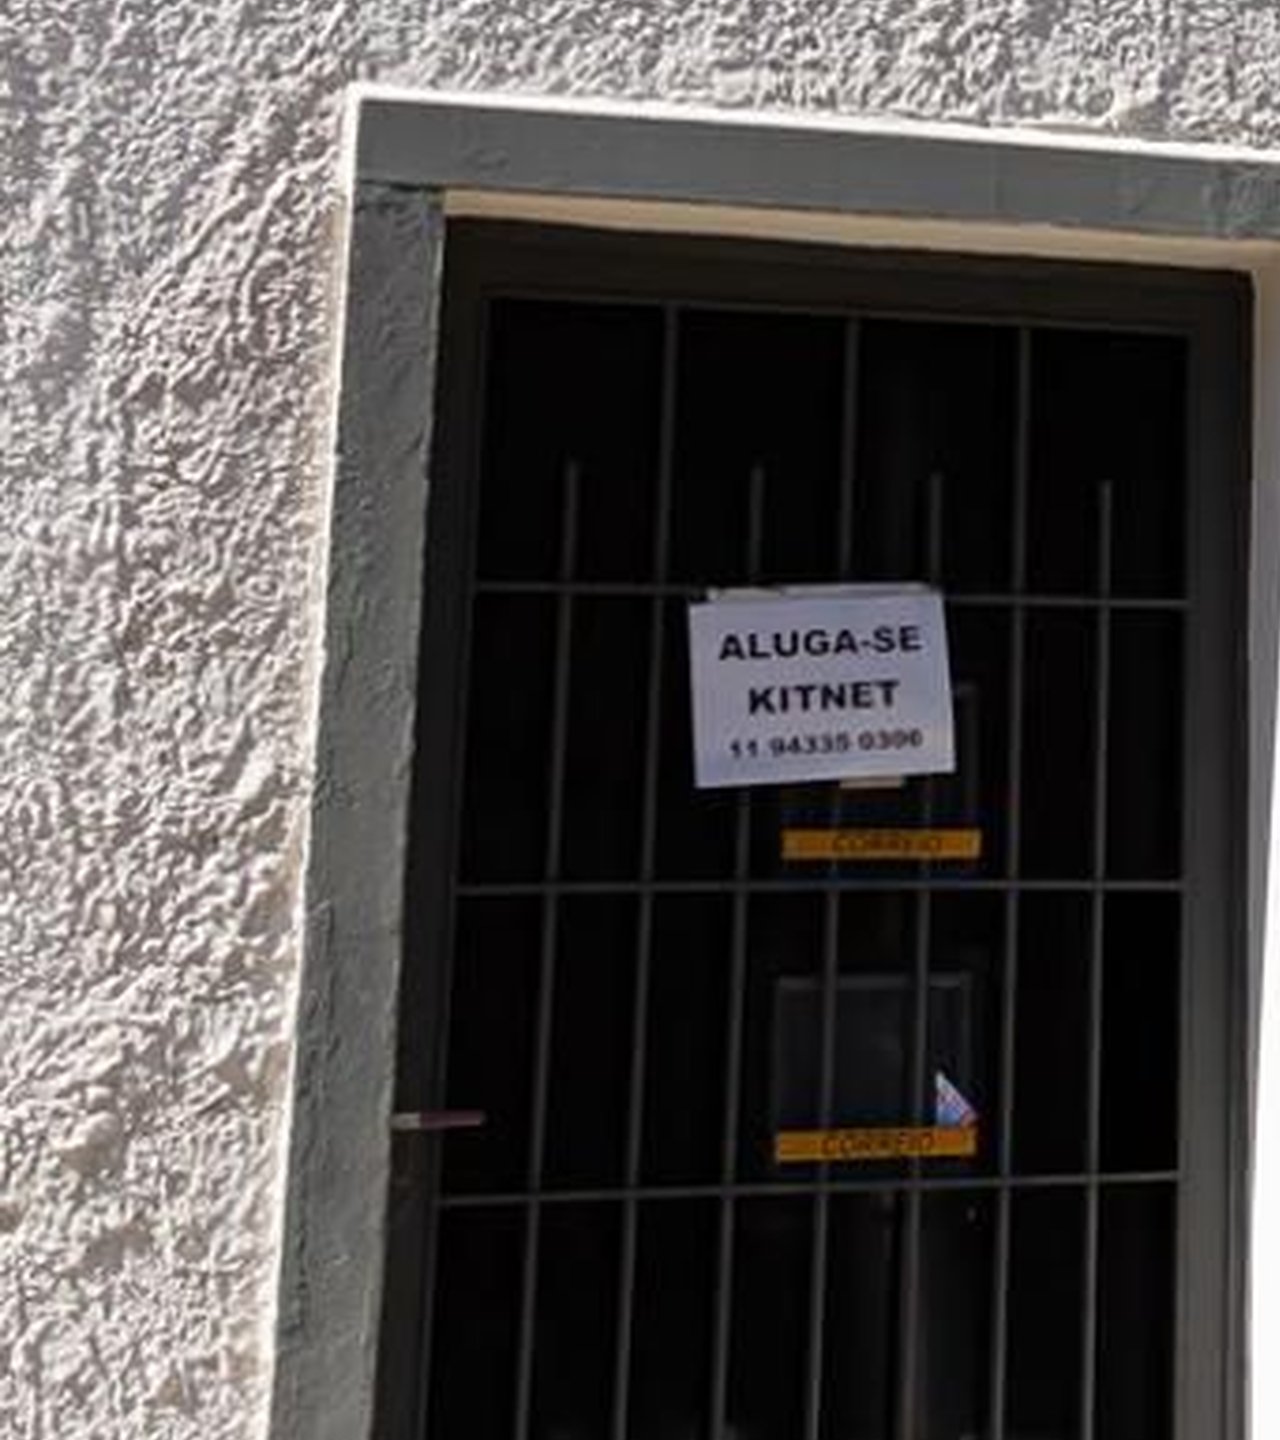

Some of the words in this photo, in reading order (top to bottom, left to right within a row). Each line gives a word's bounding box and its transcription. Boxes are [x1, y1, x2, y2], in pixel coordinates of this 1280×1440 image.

[718, 625, 924, 661] ALUGA-SE
[749, 679, 901, 715] KITNET
[729, 738, 759, 760] 11
